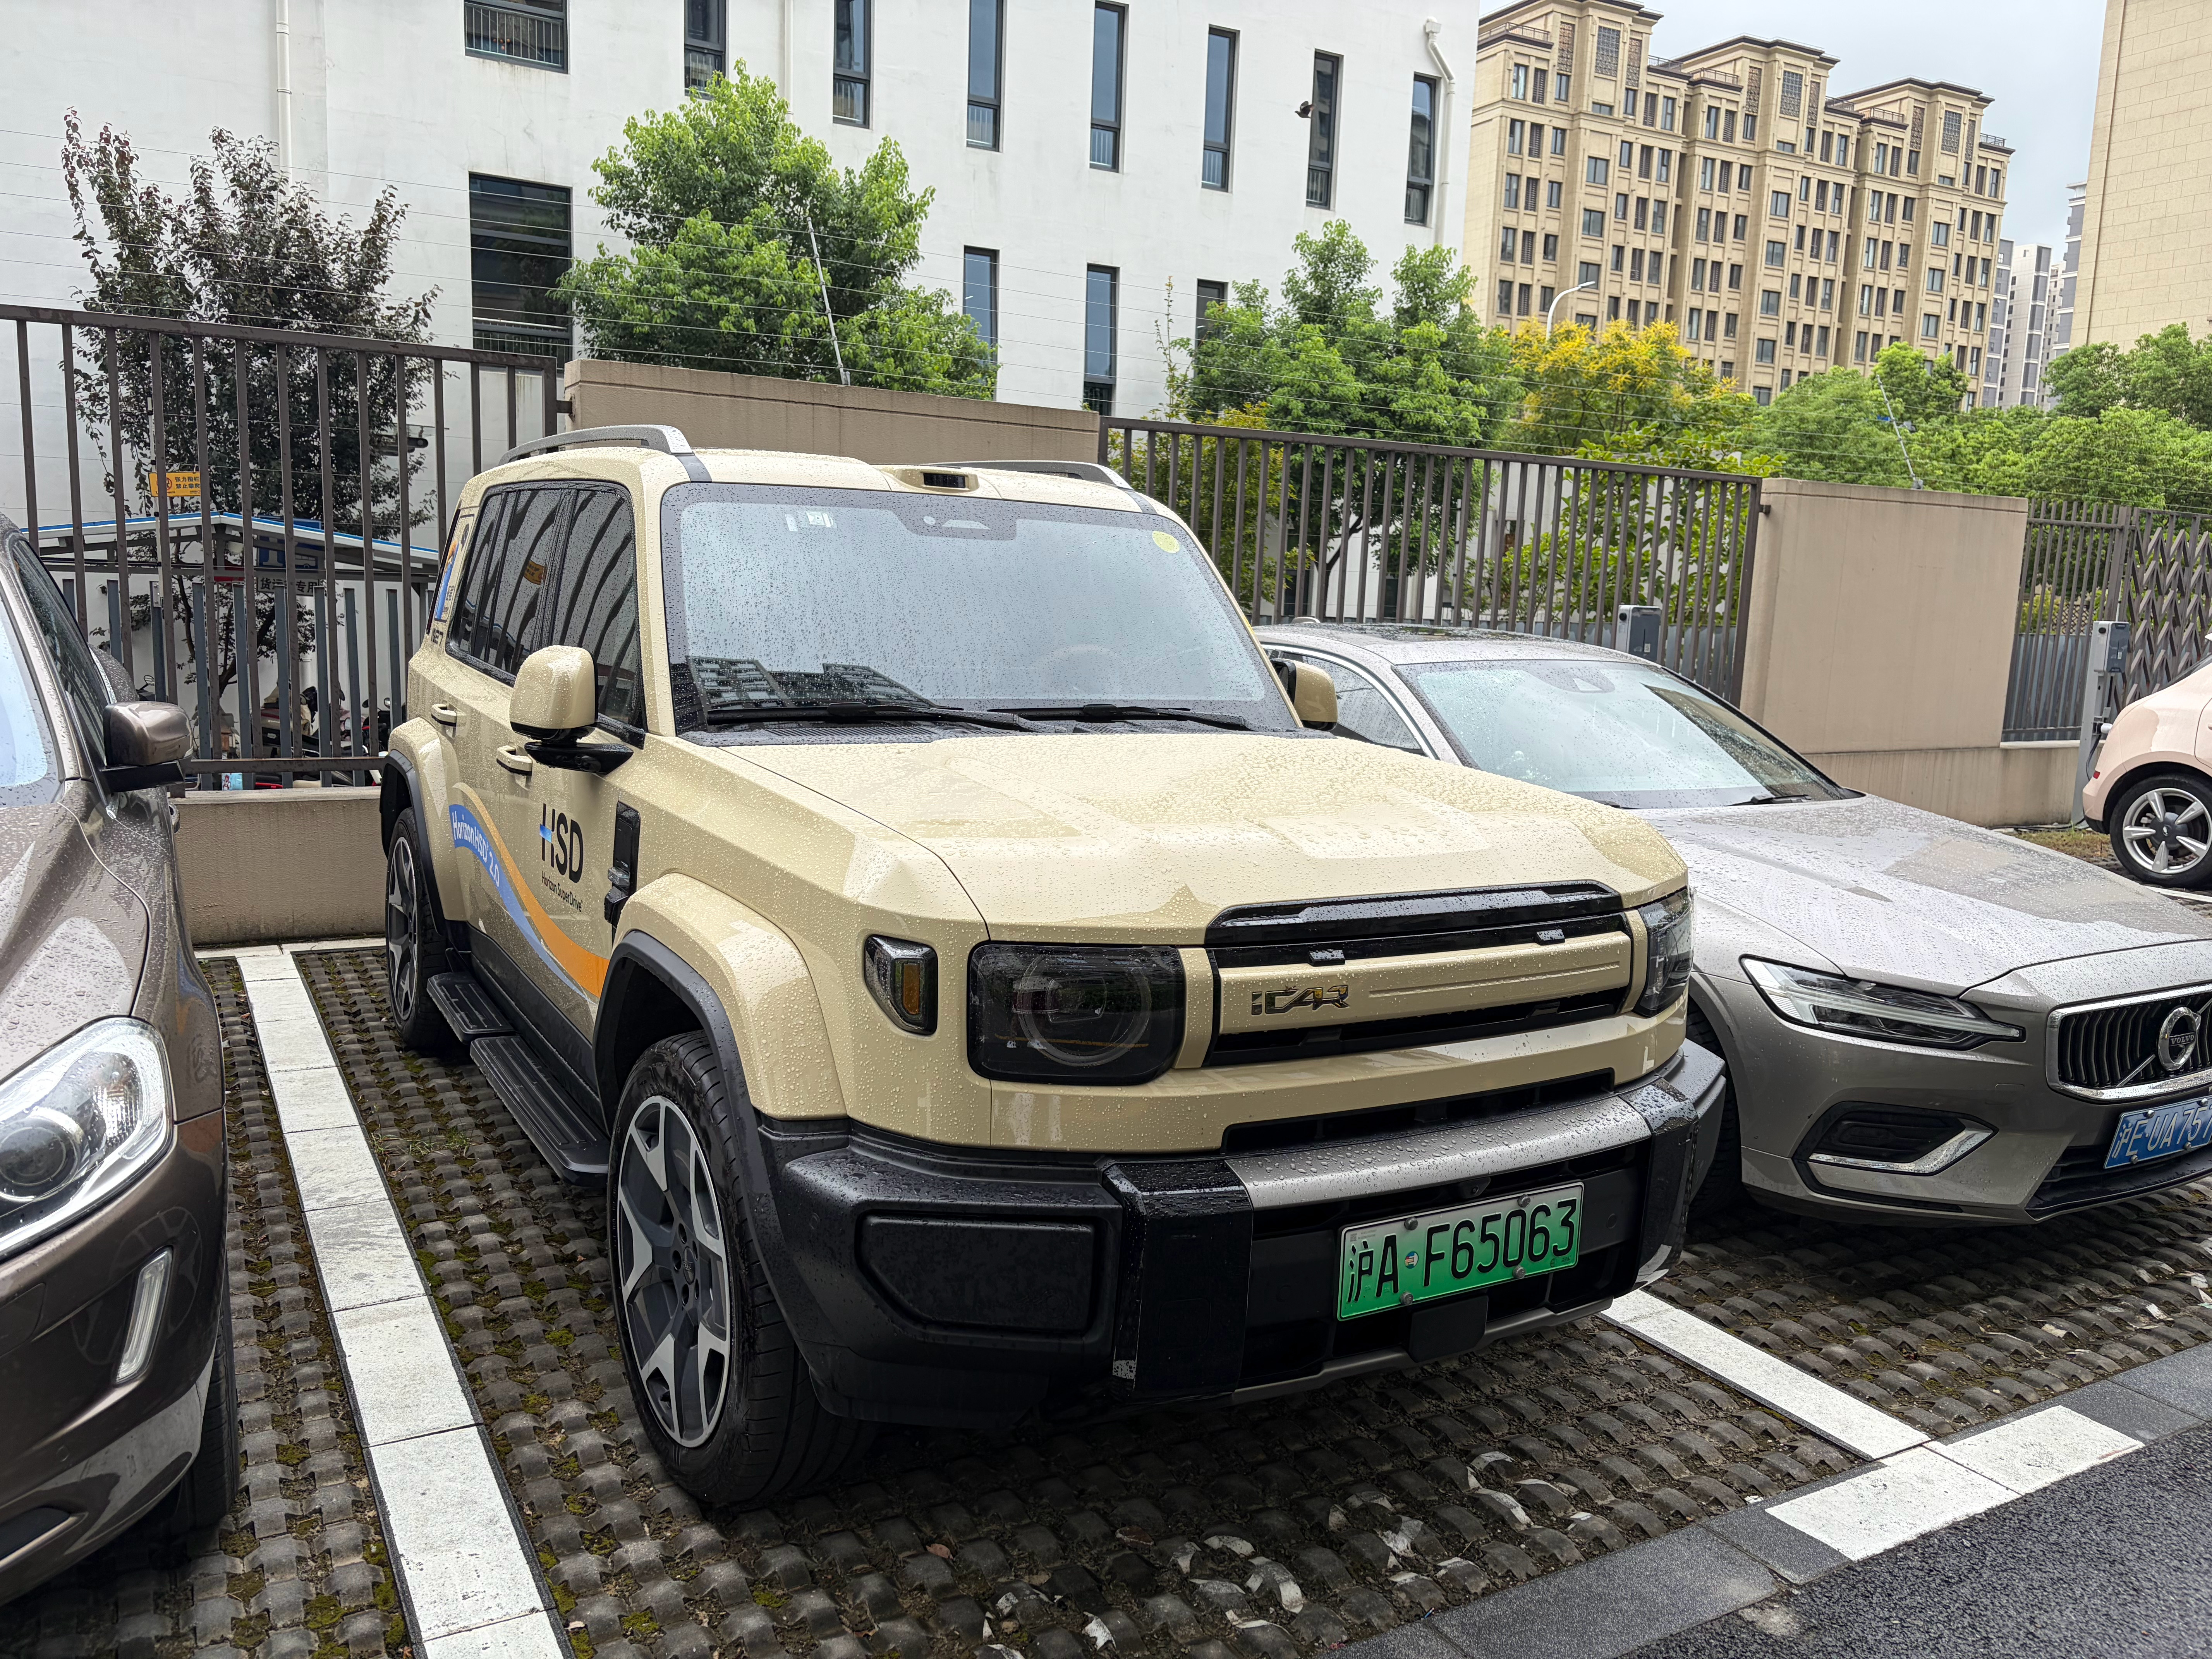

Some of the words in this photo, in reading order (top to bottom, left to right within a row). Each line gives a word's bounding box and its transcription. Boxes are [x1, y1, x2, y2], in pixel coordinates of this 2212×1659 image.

[260, 577, 318, 593] 货运专用
[539, 803, 584, 883] HSD
[489, 851, 500, 887] 2.0
[542, 871, 557, 894] Horizon
[2171, 1034, 2194, 1044] VOLVO
